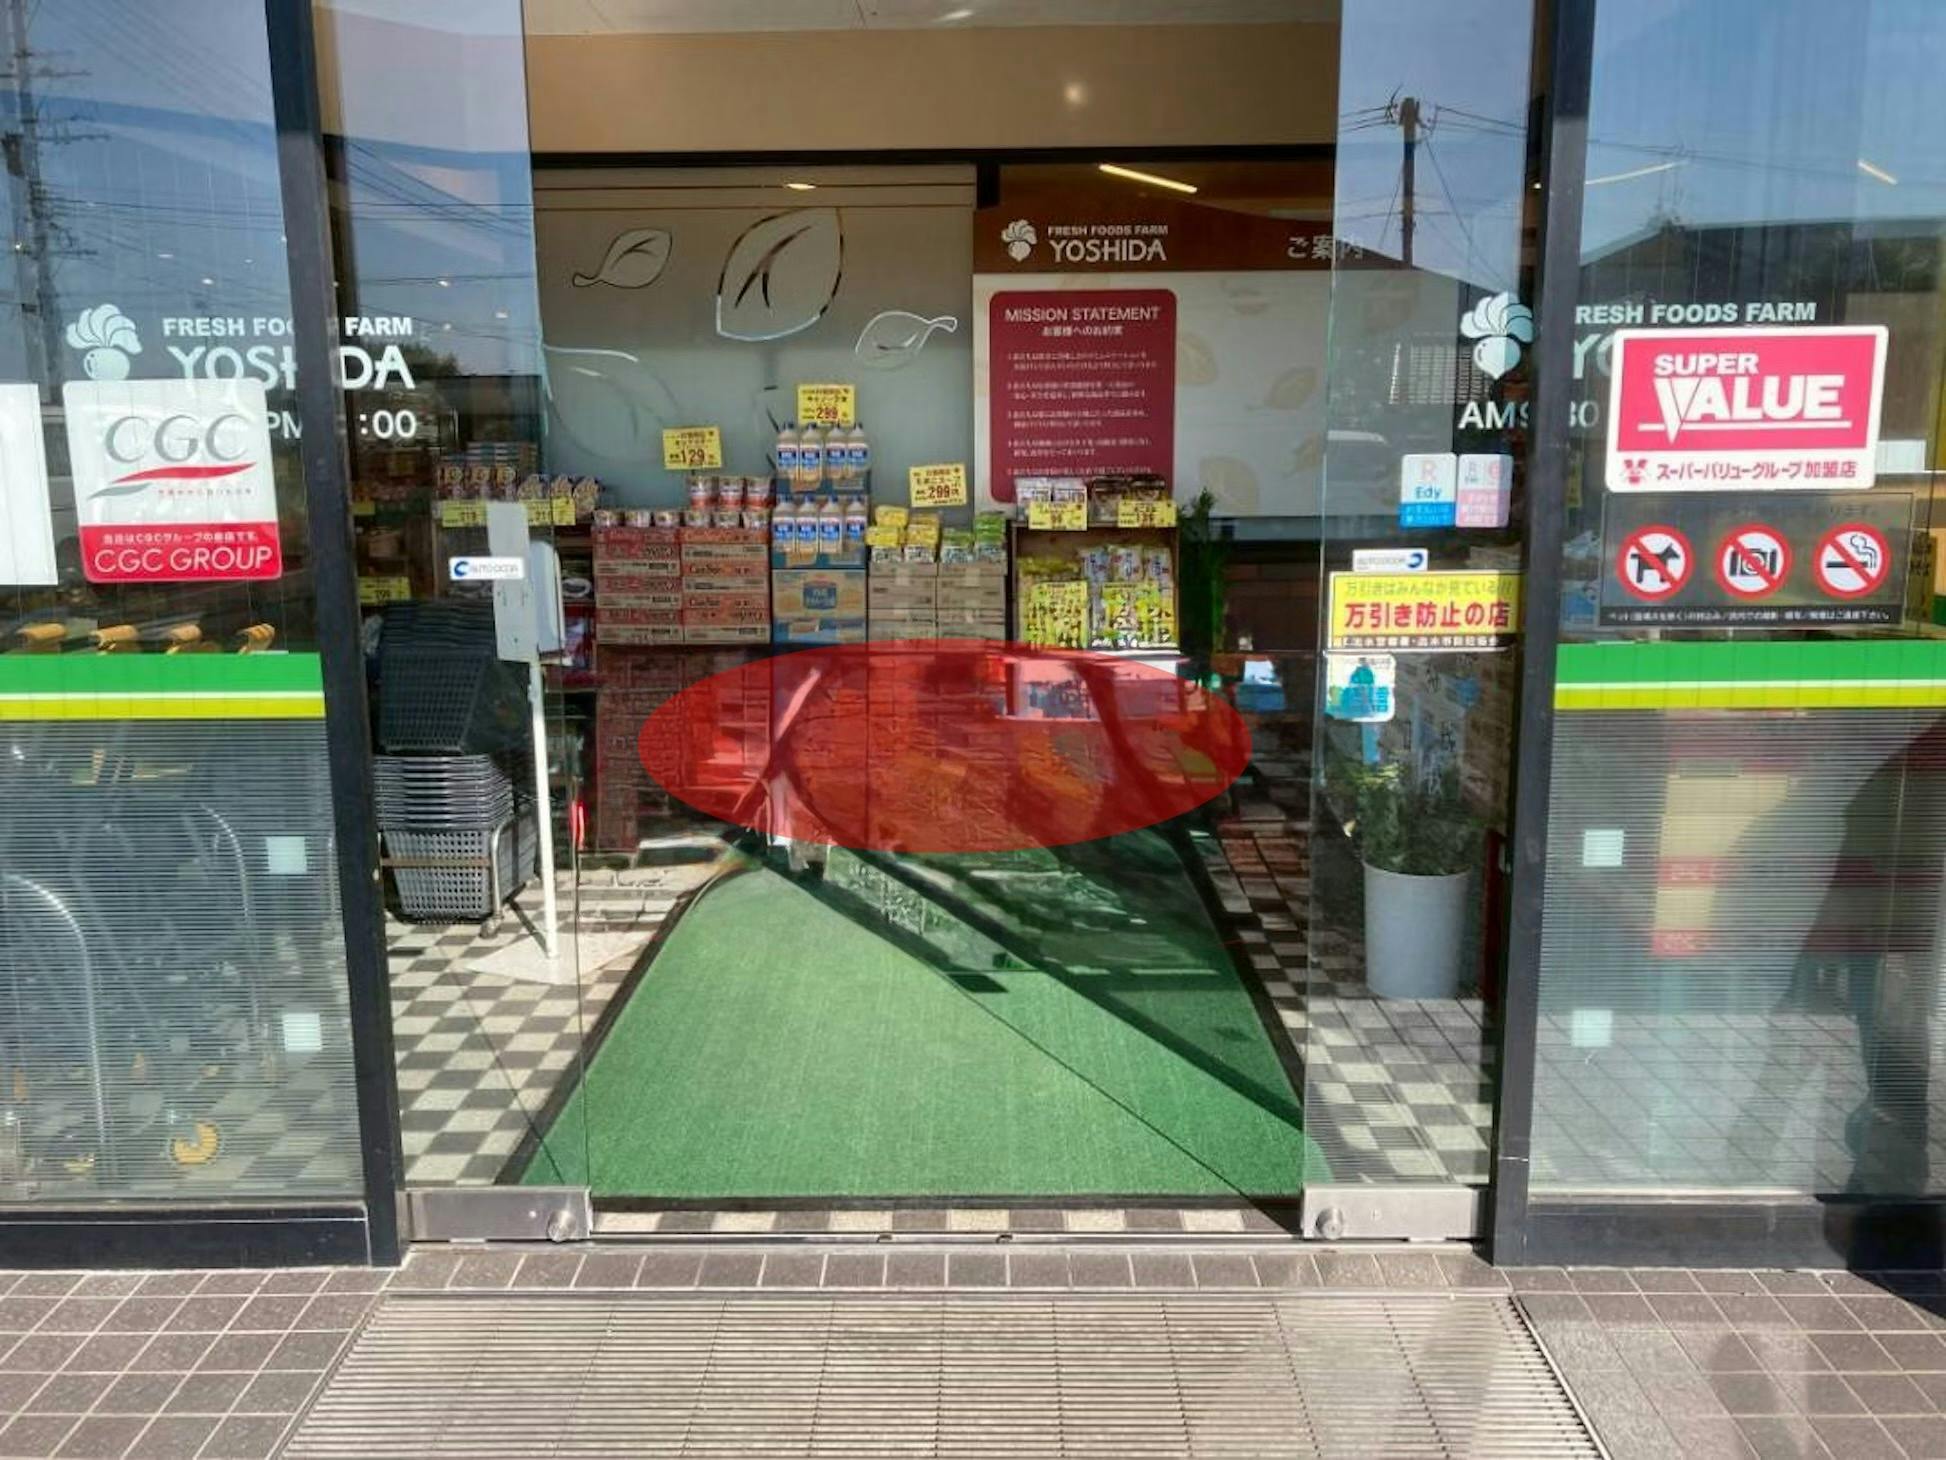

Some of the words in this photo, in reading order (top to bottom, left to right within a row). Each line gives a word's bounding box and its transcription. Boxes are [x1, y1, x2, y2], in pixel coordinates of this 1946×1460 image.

[1047, 224, 1087, 236] FRESH
[1091, 224, 1132, 236] FOODS
[1134, 224, 1169, 235] FARM
[1049, 238, 1168, 262] YOSHIDA
[1288, 234, 1363, 260] ご案内
[1005, 308, 1068, 323] MISSION
[1072, 305, 1162, 321] STATEMENT
[1575, 303, 1644, 325] RESH
[1651, 303, 1738, 324] FOODS
[1745, 302, 1817, 322] FARM
[162, 317, 245, 337] FRESH
[344, 316, 413, 337] FARM
[1654, 353, 1759, 375] SUPER
[1653, 374, 1846, 444] VALUE
[104, 414, 252, 463] CGC
[1415, 486, 1442, 500] Edy
[94, 549, 163, 574] CGC
[169, 546, 273, 572] GROUP
[1345, 601, 1510, 629] 万引き防止の店
